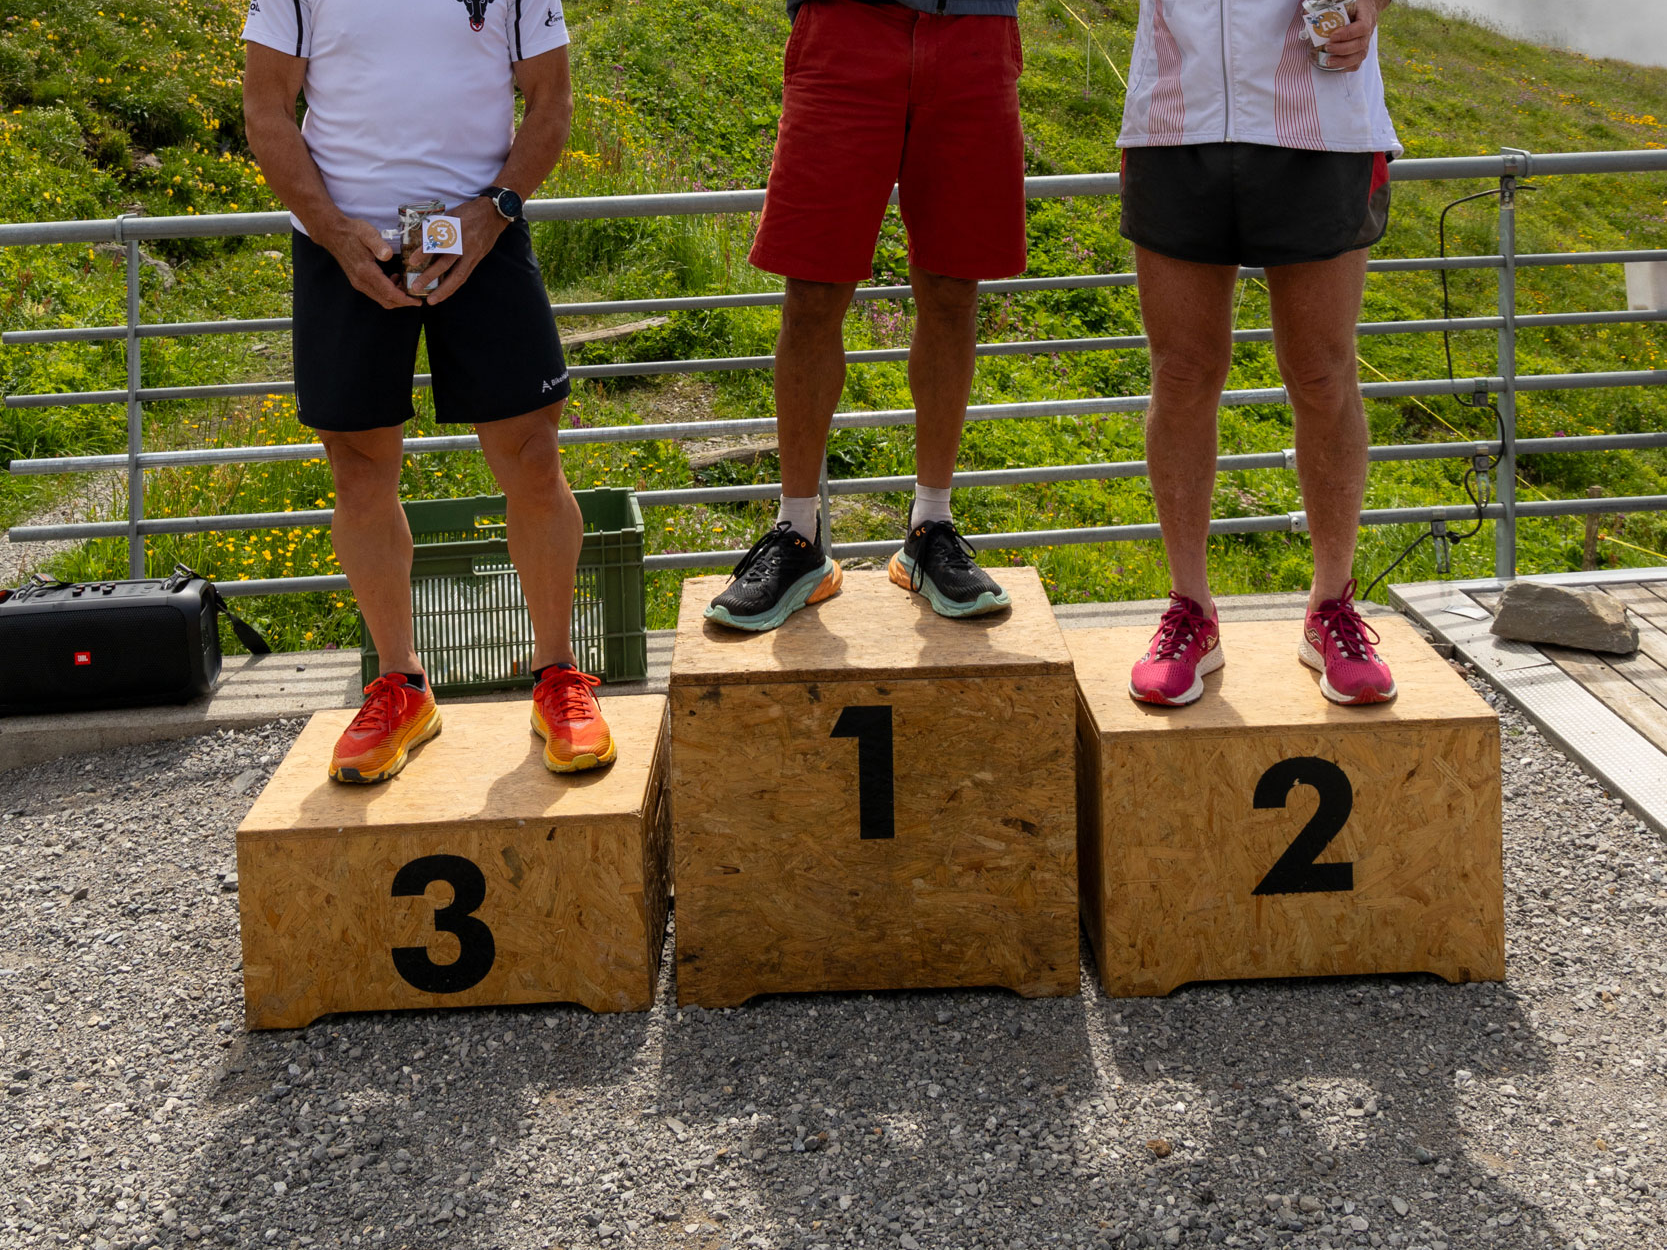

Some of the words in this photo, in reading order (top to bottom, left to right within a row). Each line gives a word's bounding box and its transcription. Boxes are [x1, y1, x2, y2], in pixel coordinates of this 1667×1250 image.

[1321, 20, 1337, 32] 2
[437, 226, 450, 241] 3
[830, 705, 895, 840] 1
[1252, 757, 1353, 896] 2
[391, 854, 496, 994] 3
